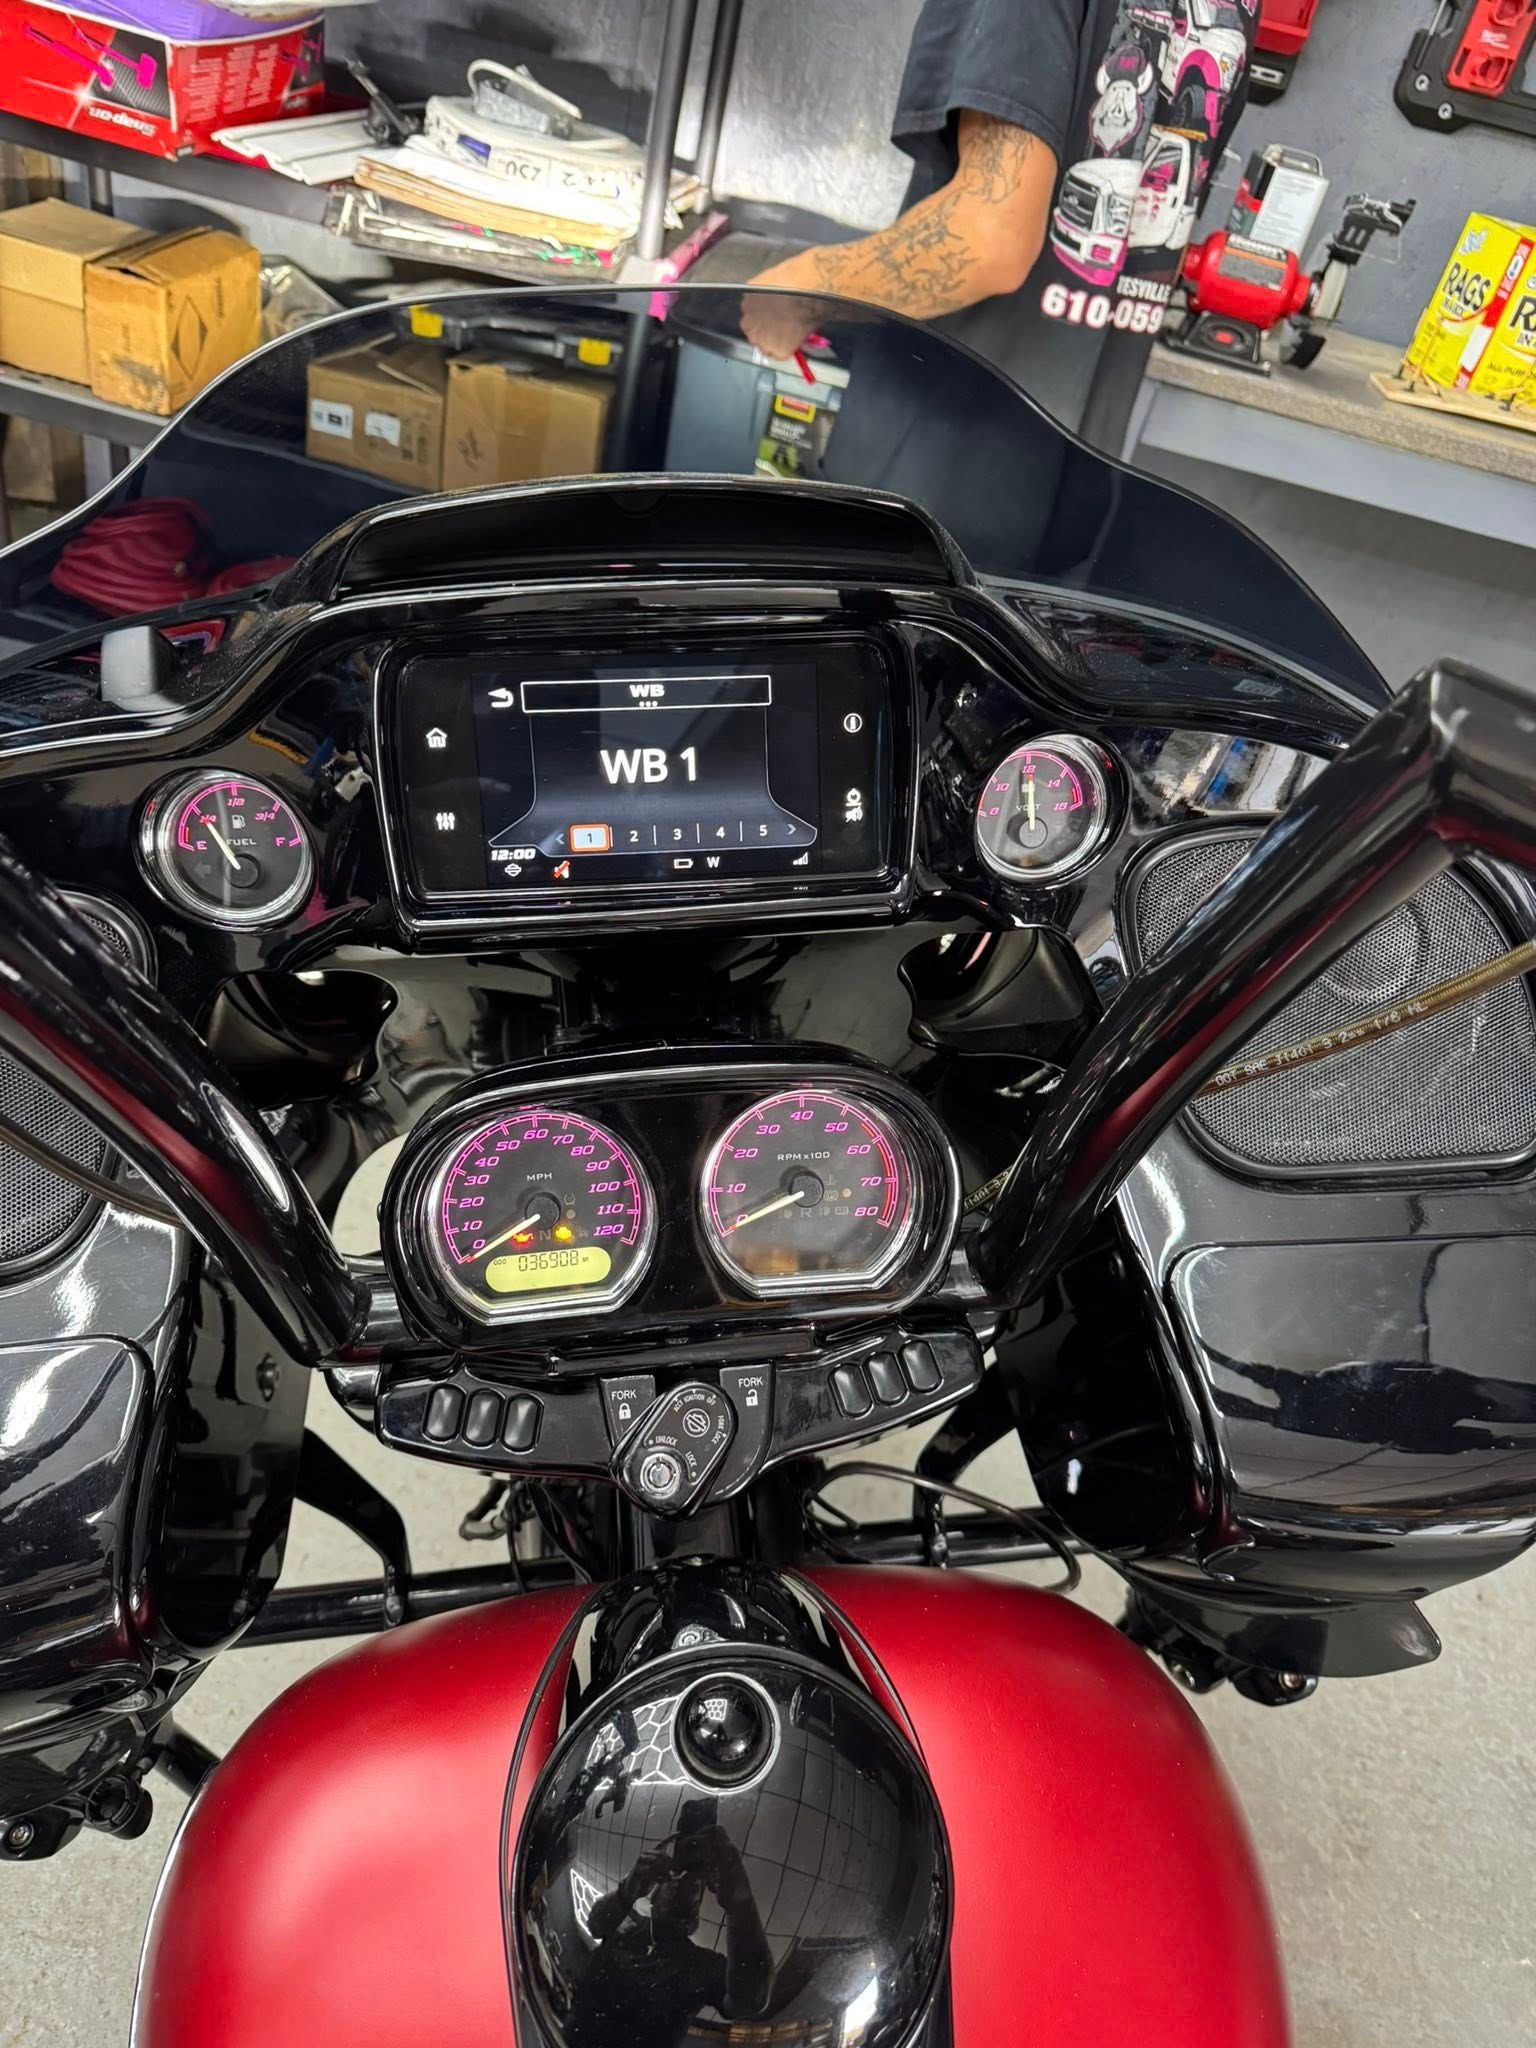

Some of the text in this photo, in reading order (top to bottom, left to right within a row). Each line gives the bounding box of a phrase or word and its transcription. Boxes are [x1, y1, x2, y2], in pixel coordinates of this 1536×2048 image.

[1442, 262, 1491, 311] RAGS
[1510, 294, 1536, 331] R
[629, 683, 666, 698] WB
[600, 747, 697, 785] WB 1
[994, 783, 1010, 792] 10
[1046, 779, 1061, 788] 14
[1015, 803, 1040, 812] VOT
[254, 812, 276, 822] 3/4
[585, 824, 768, 844] 1 2 3 4 5
[196, 840, 208, 850] E
[225, 838, 257, 846] FUEL
[275, 837, 286, 847] F
[490, 848, 536, 861] 12:00
[706, 856, 721, 868] W
[1243, 1059, 1267, 1076] SAE
[1275, 1045, 1314, 1065] J1401
[789, 1110, 814, 1121] 40
[755, 1124, 781, 1135] 30
[824, 1122, 849, 1132] 50
[523, 1129, 549, 1140] 60
[552, 1134, 575, 1145] 70
[495, 1140, 521, 1151] 50
[570, 1145, 595, 1156] 80
[846, 1144, 872, 1155] 60
[733, 1148, 759, 1158] 20
[777, 1153, 802, 1161] RPM
[474, 1156, 500, 1167] 40
[585, 1160, 610, 1172] 90
[463, 1174, 490, 1186] 30
[526, 1172, 553, 1182] MPH
[860, 1176, 882, 1187] 70
[588, 1181, 620, 1193] 100
[726, 1183, 747, 1193] 10
[458, 1196, 485, 1208] 20
[596, 1203, 624, 1215] 110
[854, 1206, 879, 1217] 80
[462, 1220, 483, 1231] 10
[593, 1224, 625, 1236] 120
[472, 1239, 486, 1250] 0
[518, 1250, 579, 1272] 036908
[738, 1376, 764, 1387] FORK
[611, 1389, 637, 1400] FORK
[683, 1393, 706, 1403] IGNITION
[655, 1435, 679, 1447] UNLOCK
[711, 1430, 723, 1445] LOCK
[685, 1450, 698, 1468] LOCK
